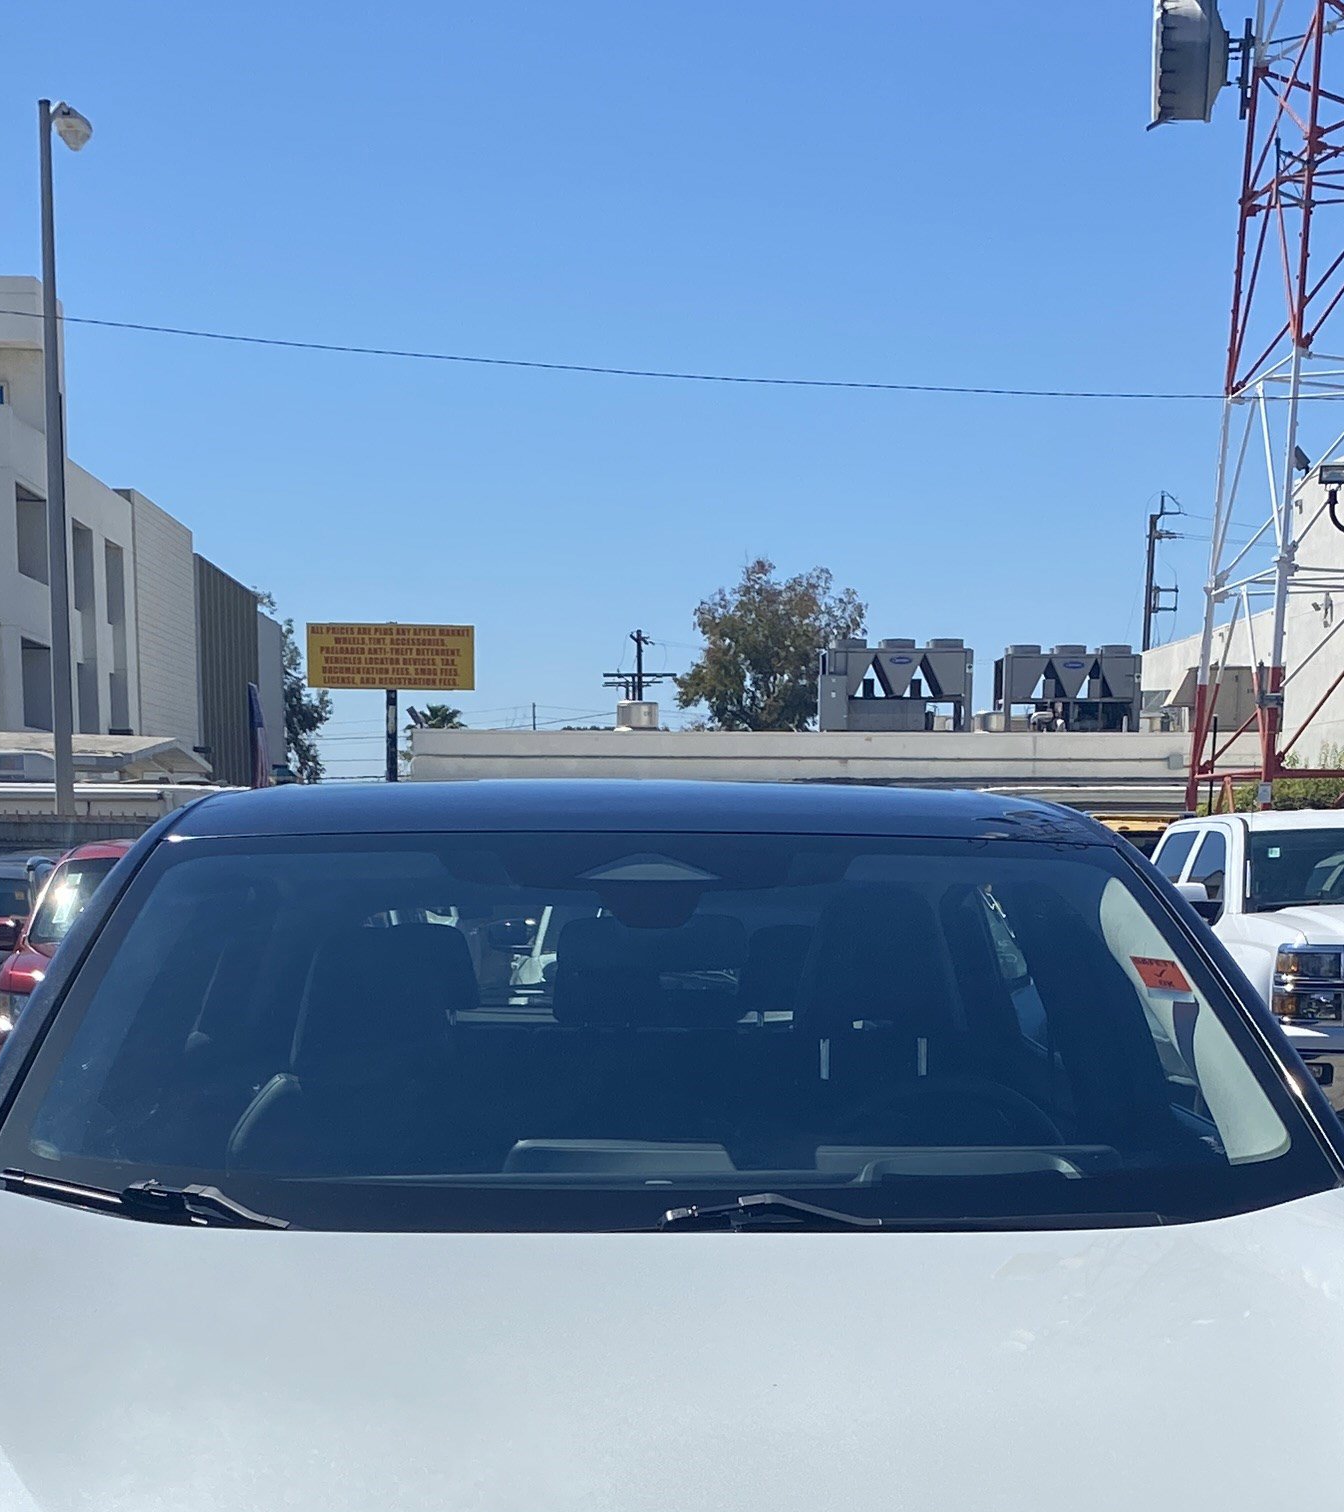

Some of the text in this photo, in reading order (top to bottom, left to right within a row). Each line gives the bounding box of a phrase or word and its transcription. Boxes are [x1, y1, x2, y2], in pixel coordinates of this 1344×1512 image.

[311, 626, 323, 634] ALL
[326, 627, 354, 635] PRICES
[357, 627, 371, 635] ARE
[396, 628, 411, 636] ANY
[413, 628, 436, 636] AFTER
[439, 629, 470, 637] MARKET
[320, 646, 365, 654] PRELOADED
[368, 647, 413, 655] ANTI-THEFT
[324, 656, 361, 664] VEHICLES
[364, 657, 400, 665] LOCATOR
[322, 666, 389, 675] DOCUMENTATION
[415, 668, 437, 676] SMOG
[360, 677, 376, 685] AND
[379, 677, 437, 685] REGISTRATION
